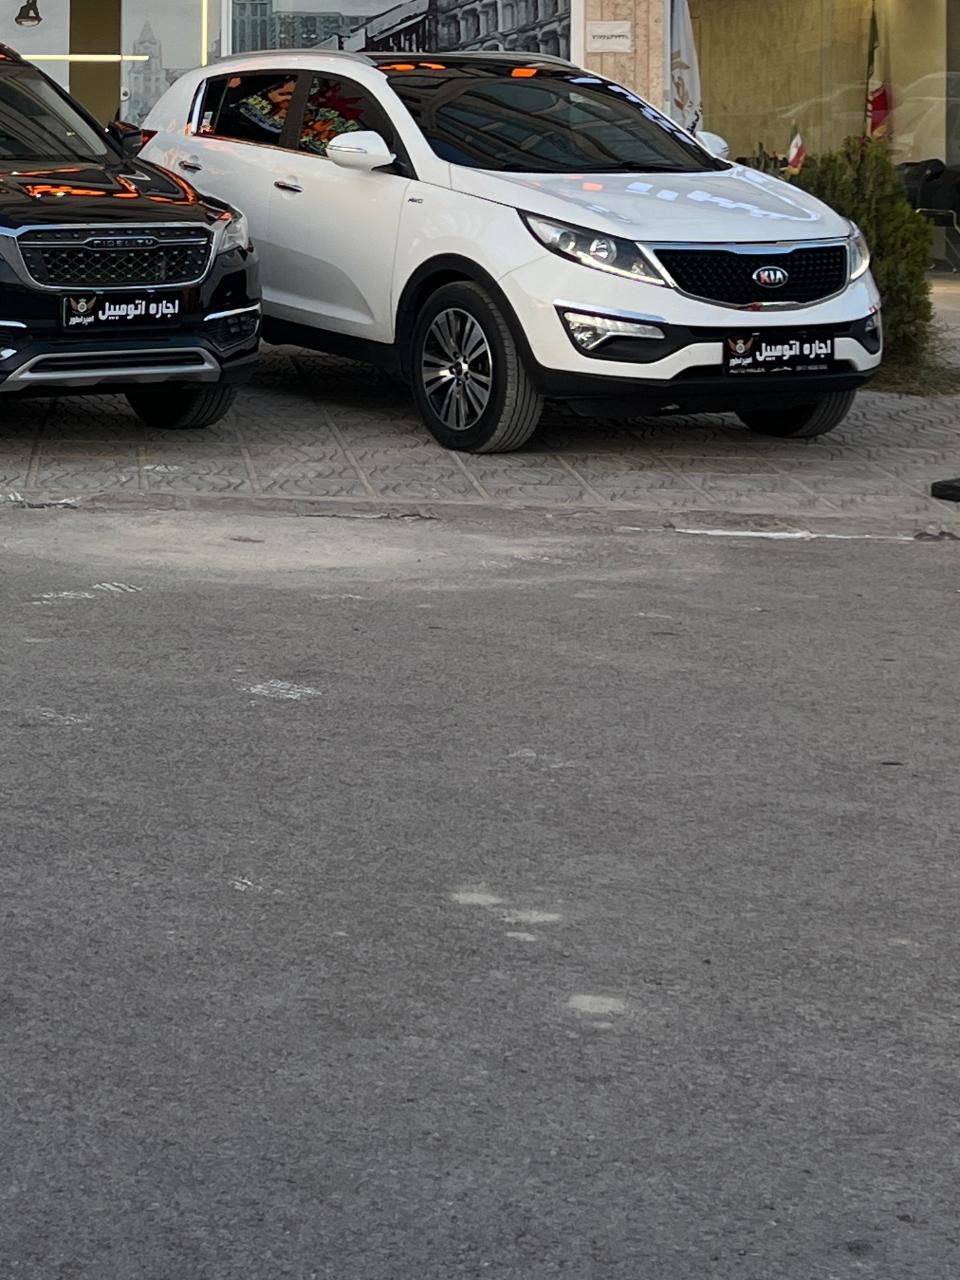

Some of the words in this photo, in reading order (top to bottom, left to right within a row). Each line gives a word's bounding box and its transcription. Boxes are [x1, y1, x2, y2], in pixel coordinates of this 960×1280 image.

[758, 269, 785, 283] KIA
[98, 299, 146, 321] اتومبیل
[149, 299, 179, 319] اجاره
[755, 340, 800, 362] اتومبیل
[803, 339, 831, 359] اجاره
